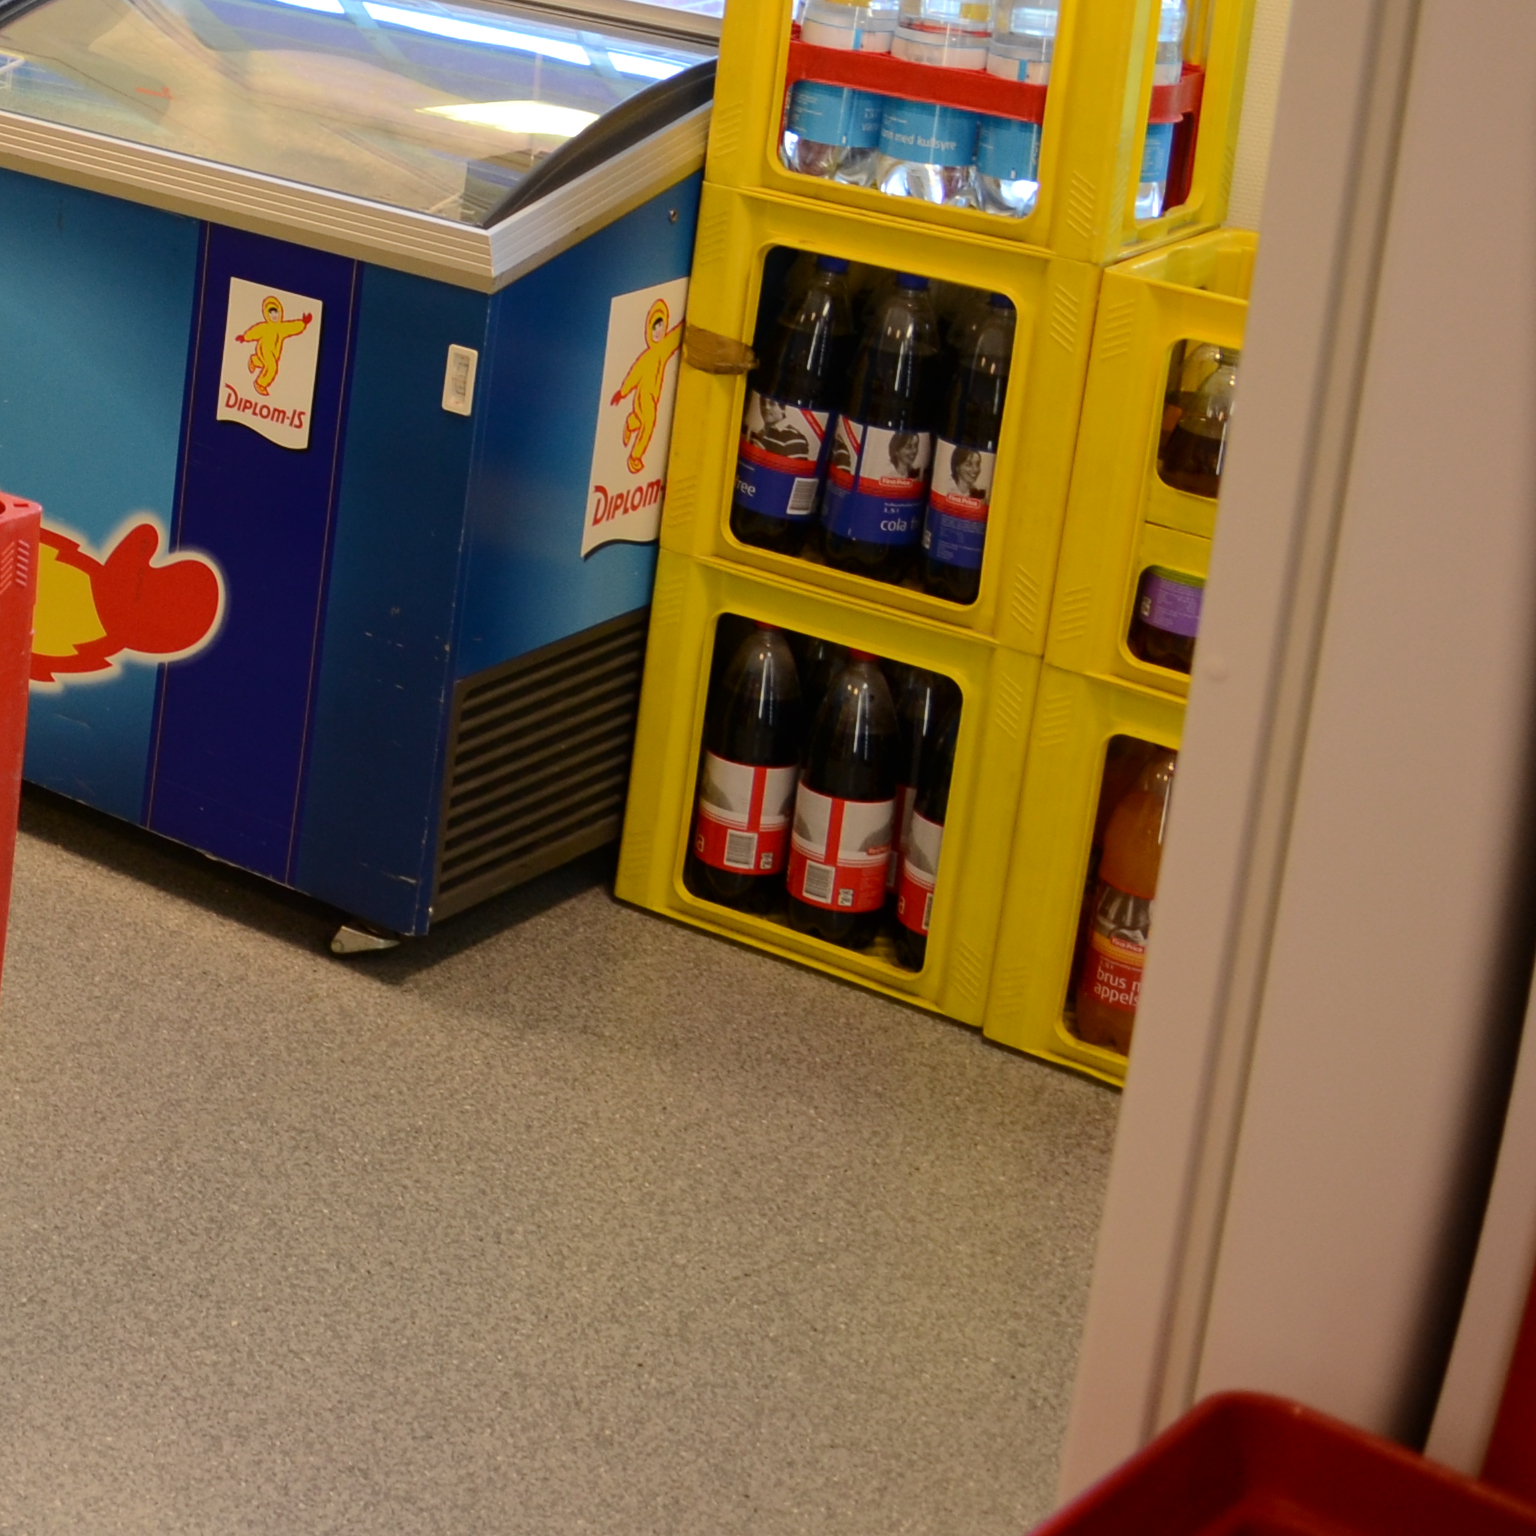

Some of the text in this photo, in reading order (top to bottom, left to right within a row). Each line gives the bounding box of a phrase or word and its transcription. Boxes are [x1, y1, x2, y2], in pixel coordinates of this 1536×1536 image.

[895, 131, 956, 152] med kullsyre
[224, 383, 306, 430] DIPLOM-IS
[736, 478, 756, 497] ree
[592, 478, 666, 527] DIPLOM-
[880, 518, 907, 532] cola
[1096, 965, 1127, 989] brus
